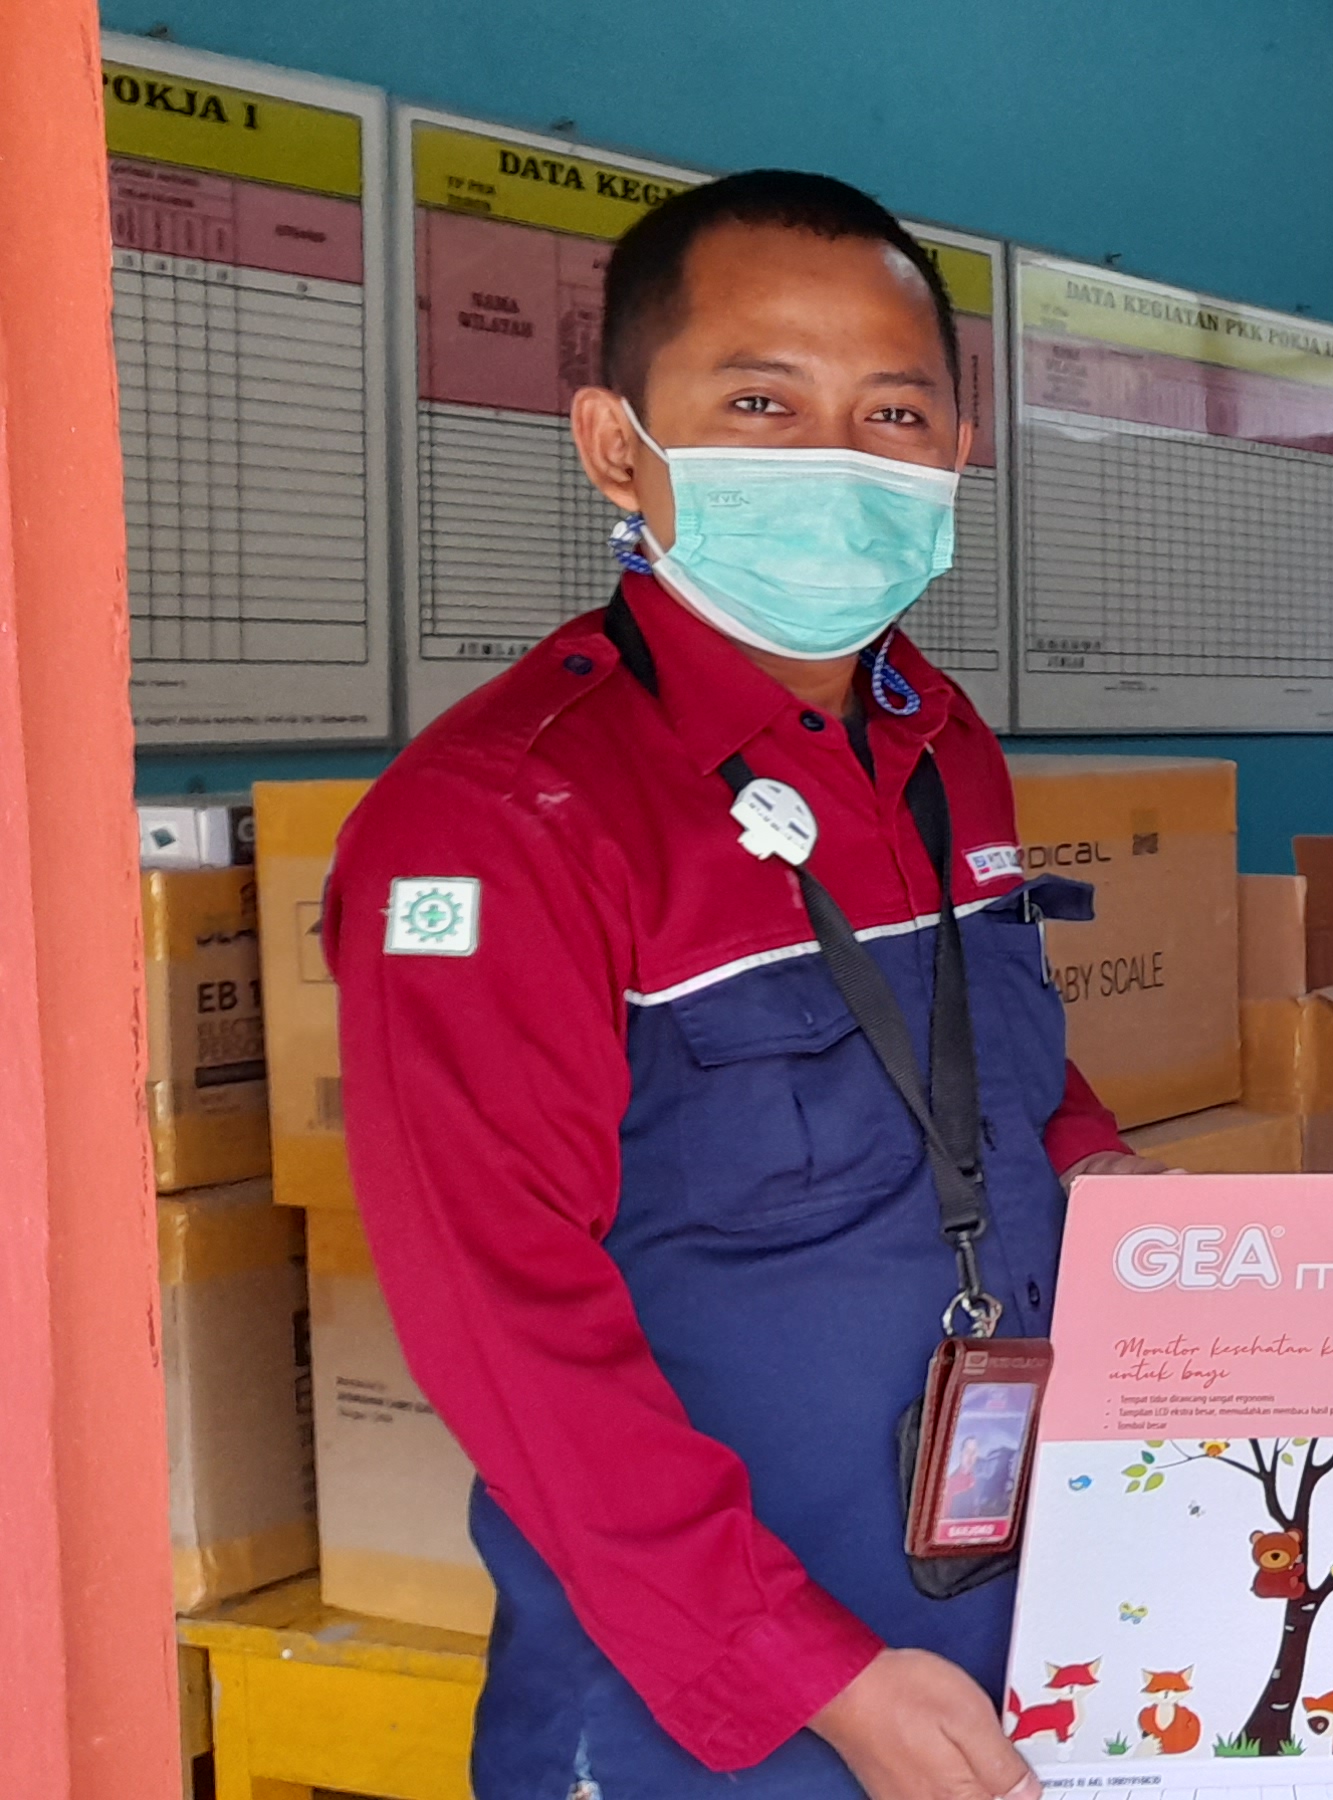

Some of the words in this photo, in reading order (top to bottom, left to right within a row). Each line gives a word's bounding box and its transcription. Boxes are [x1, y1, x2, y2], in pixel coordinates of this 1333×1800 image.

[103, 73, 229, 124] OKJA
[500, 150, 586, 190] DATA
[1066, 280, 1116, 309] DATA
[1123, 295, 1219, 332] KEGIATAN
[1225, 312, 1263, 341] PKK
[1268, 328, 1322, 355] POKJA
[1053, 962, 1093, 1003] ABY
[1101, 952, 1165, 997] SCALE
[198, 980, 238, 1013] EB
[1113, 1224, 1282, 1292] GEA
[1114, 1334, 1201, 1359] Monitor
[1210, 1333, 1312, 1359] kesehatan
[1109, 1359, 1175, 1381] untuk
[1181, 1359, 1231, 1389] bayi
[1119, 1408, 1153, 1418] Tampilan
[1155, 1408, 1169, 1417] LCD
[1273, 1406, 1309, 1415] membaca
[1311, 1406, 1329, 1415] hasil
[1235, 1395, 1275, 1404] ergonomis
